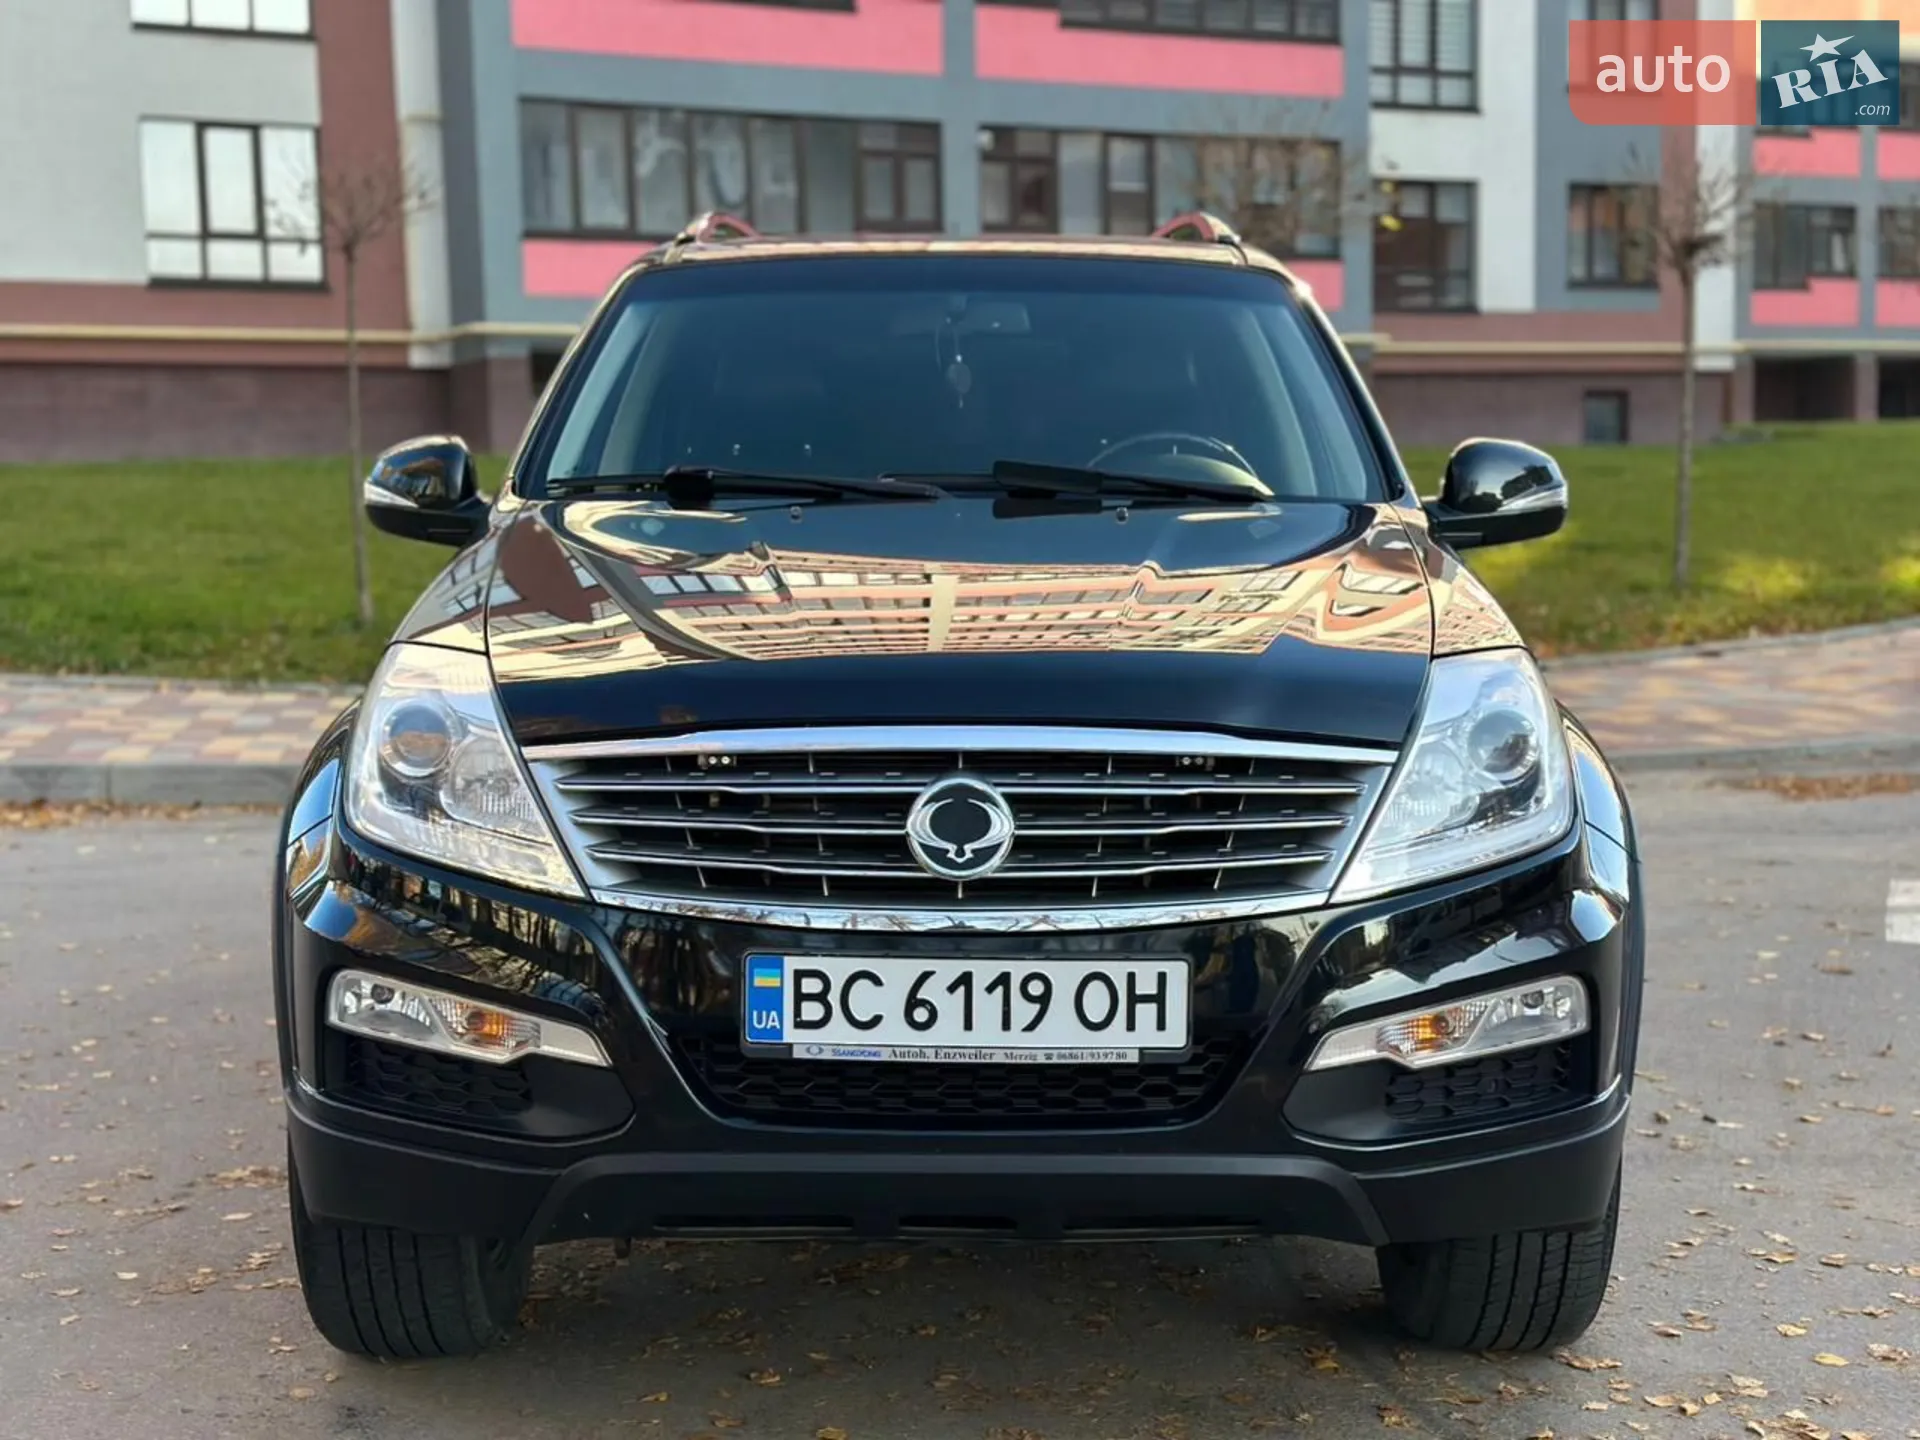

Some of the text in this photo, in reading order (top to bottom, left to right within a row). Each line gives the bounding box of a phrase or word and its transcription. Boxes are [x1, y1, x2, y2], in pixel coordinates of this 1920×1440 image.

[793, 969, 1167, 1032] BC 6119 OH
[753, 1011, 780, 1029] UA
[934, 1049, 996, 1061] Enzweiler
